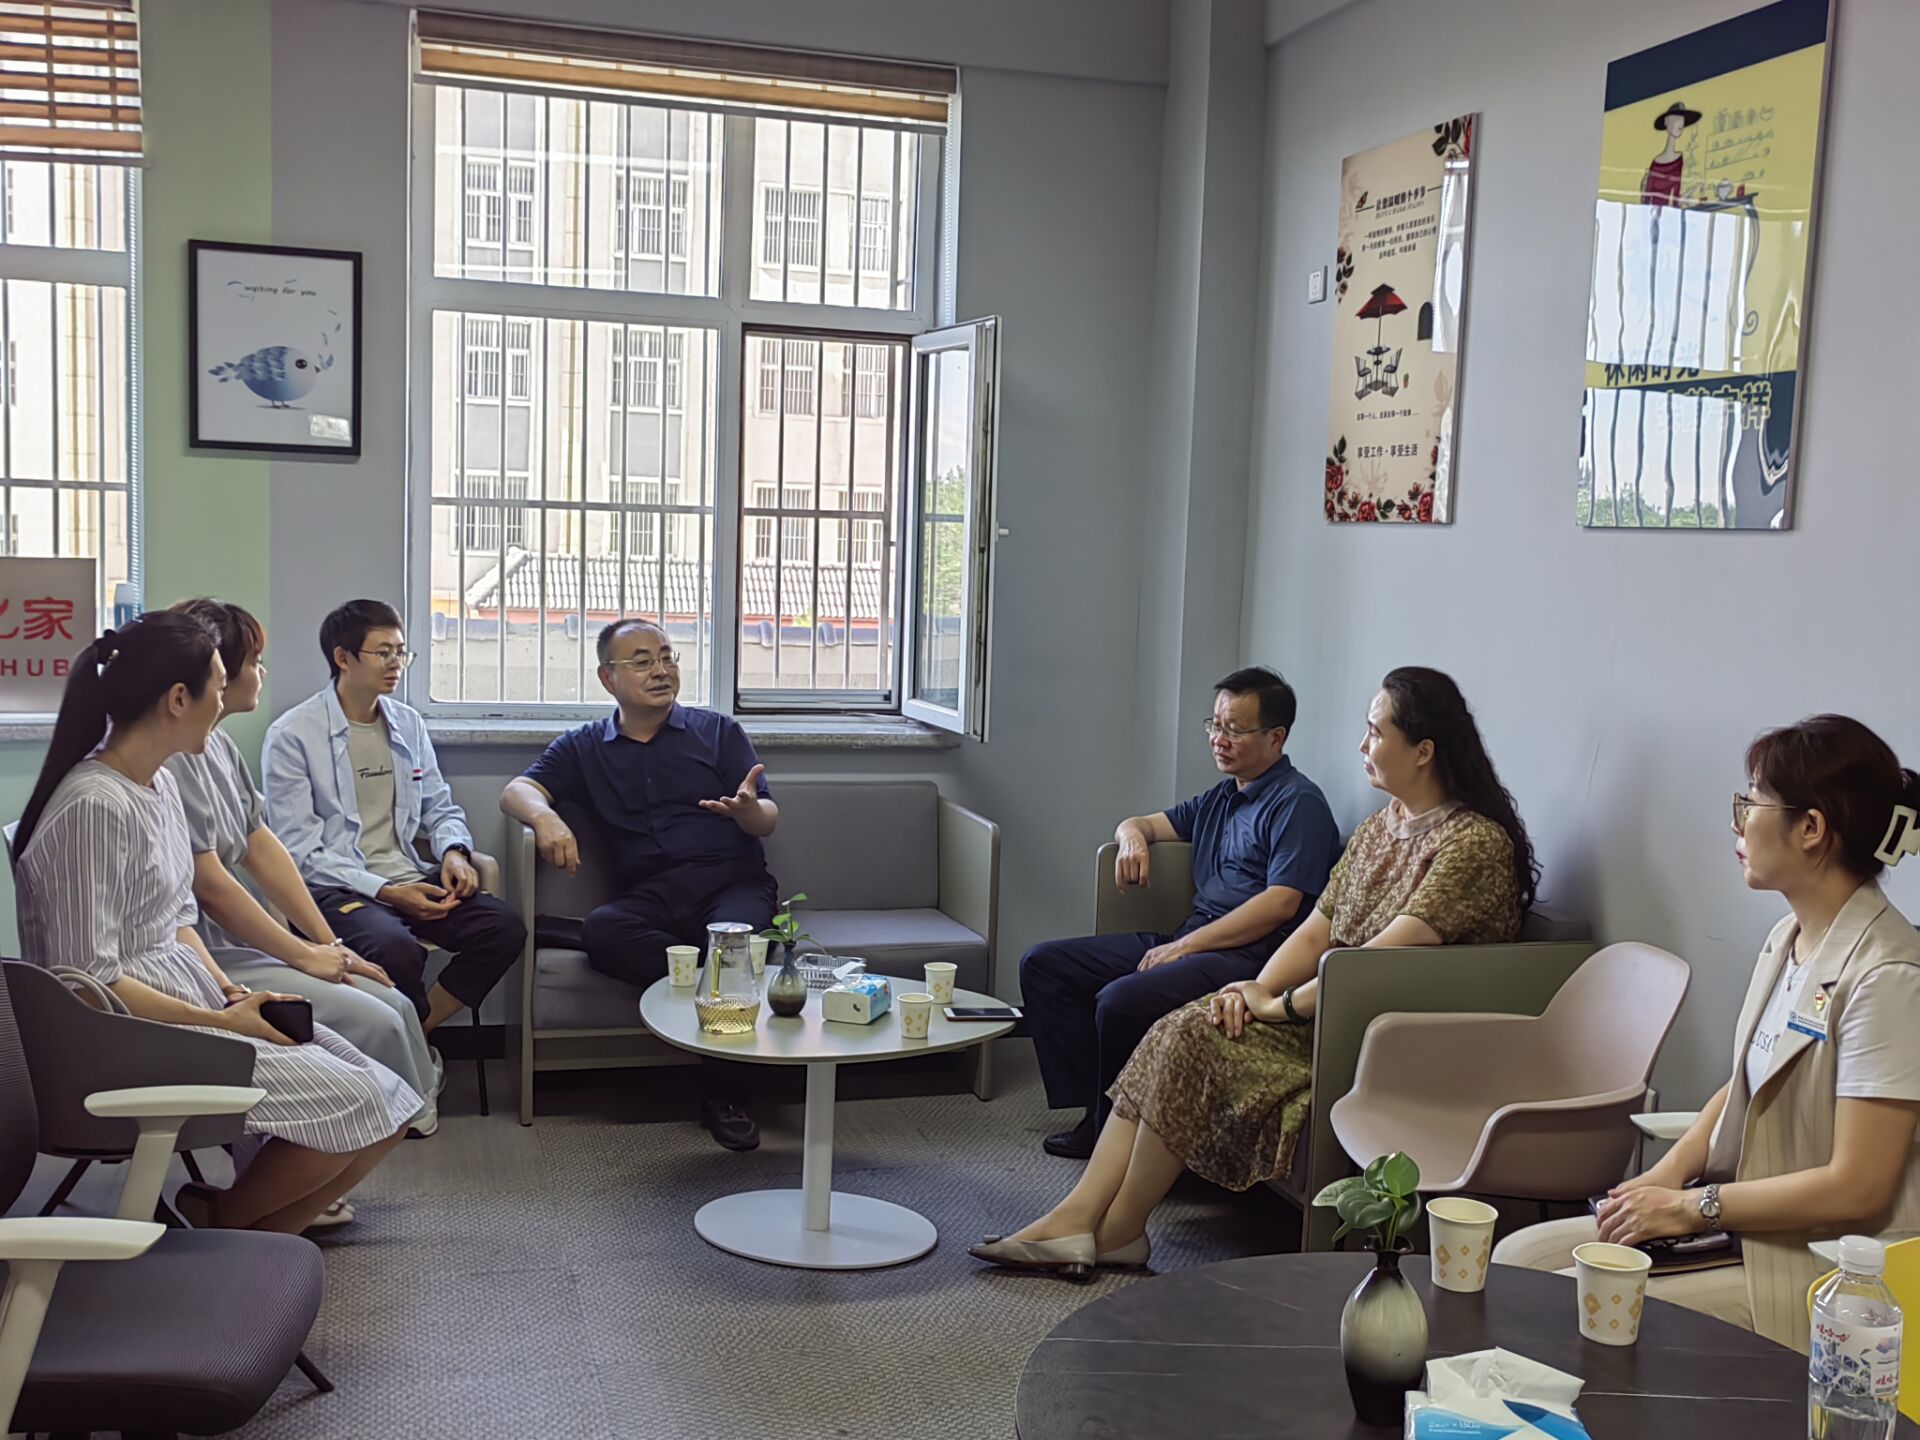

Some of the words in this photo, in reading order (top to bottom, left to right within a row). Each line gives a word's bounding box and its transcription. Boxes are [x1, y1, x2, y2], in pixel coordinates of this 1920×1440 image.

[282, 286, 296, 295] for
[301, 289, 317, 297] you
[0, 658, 69, 676] HUB
